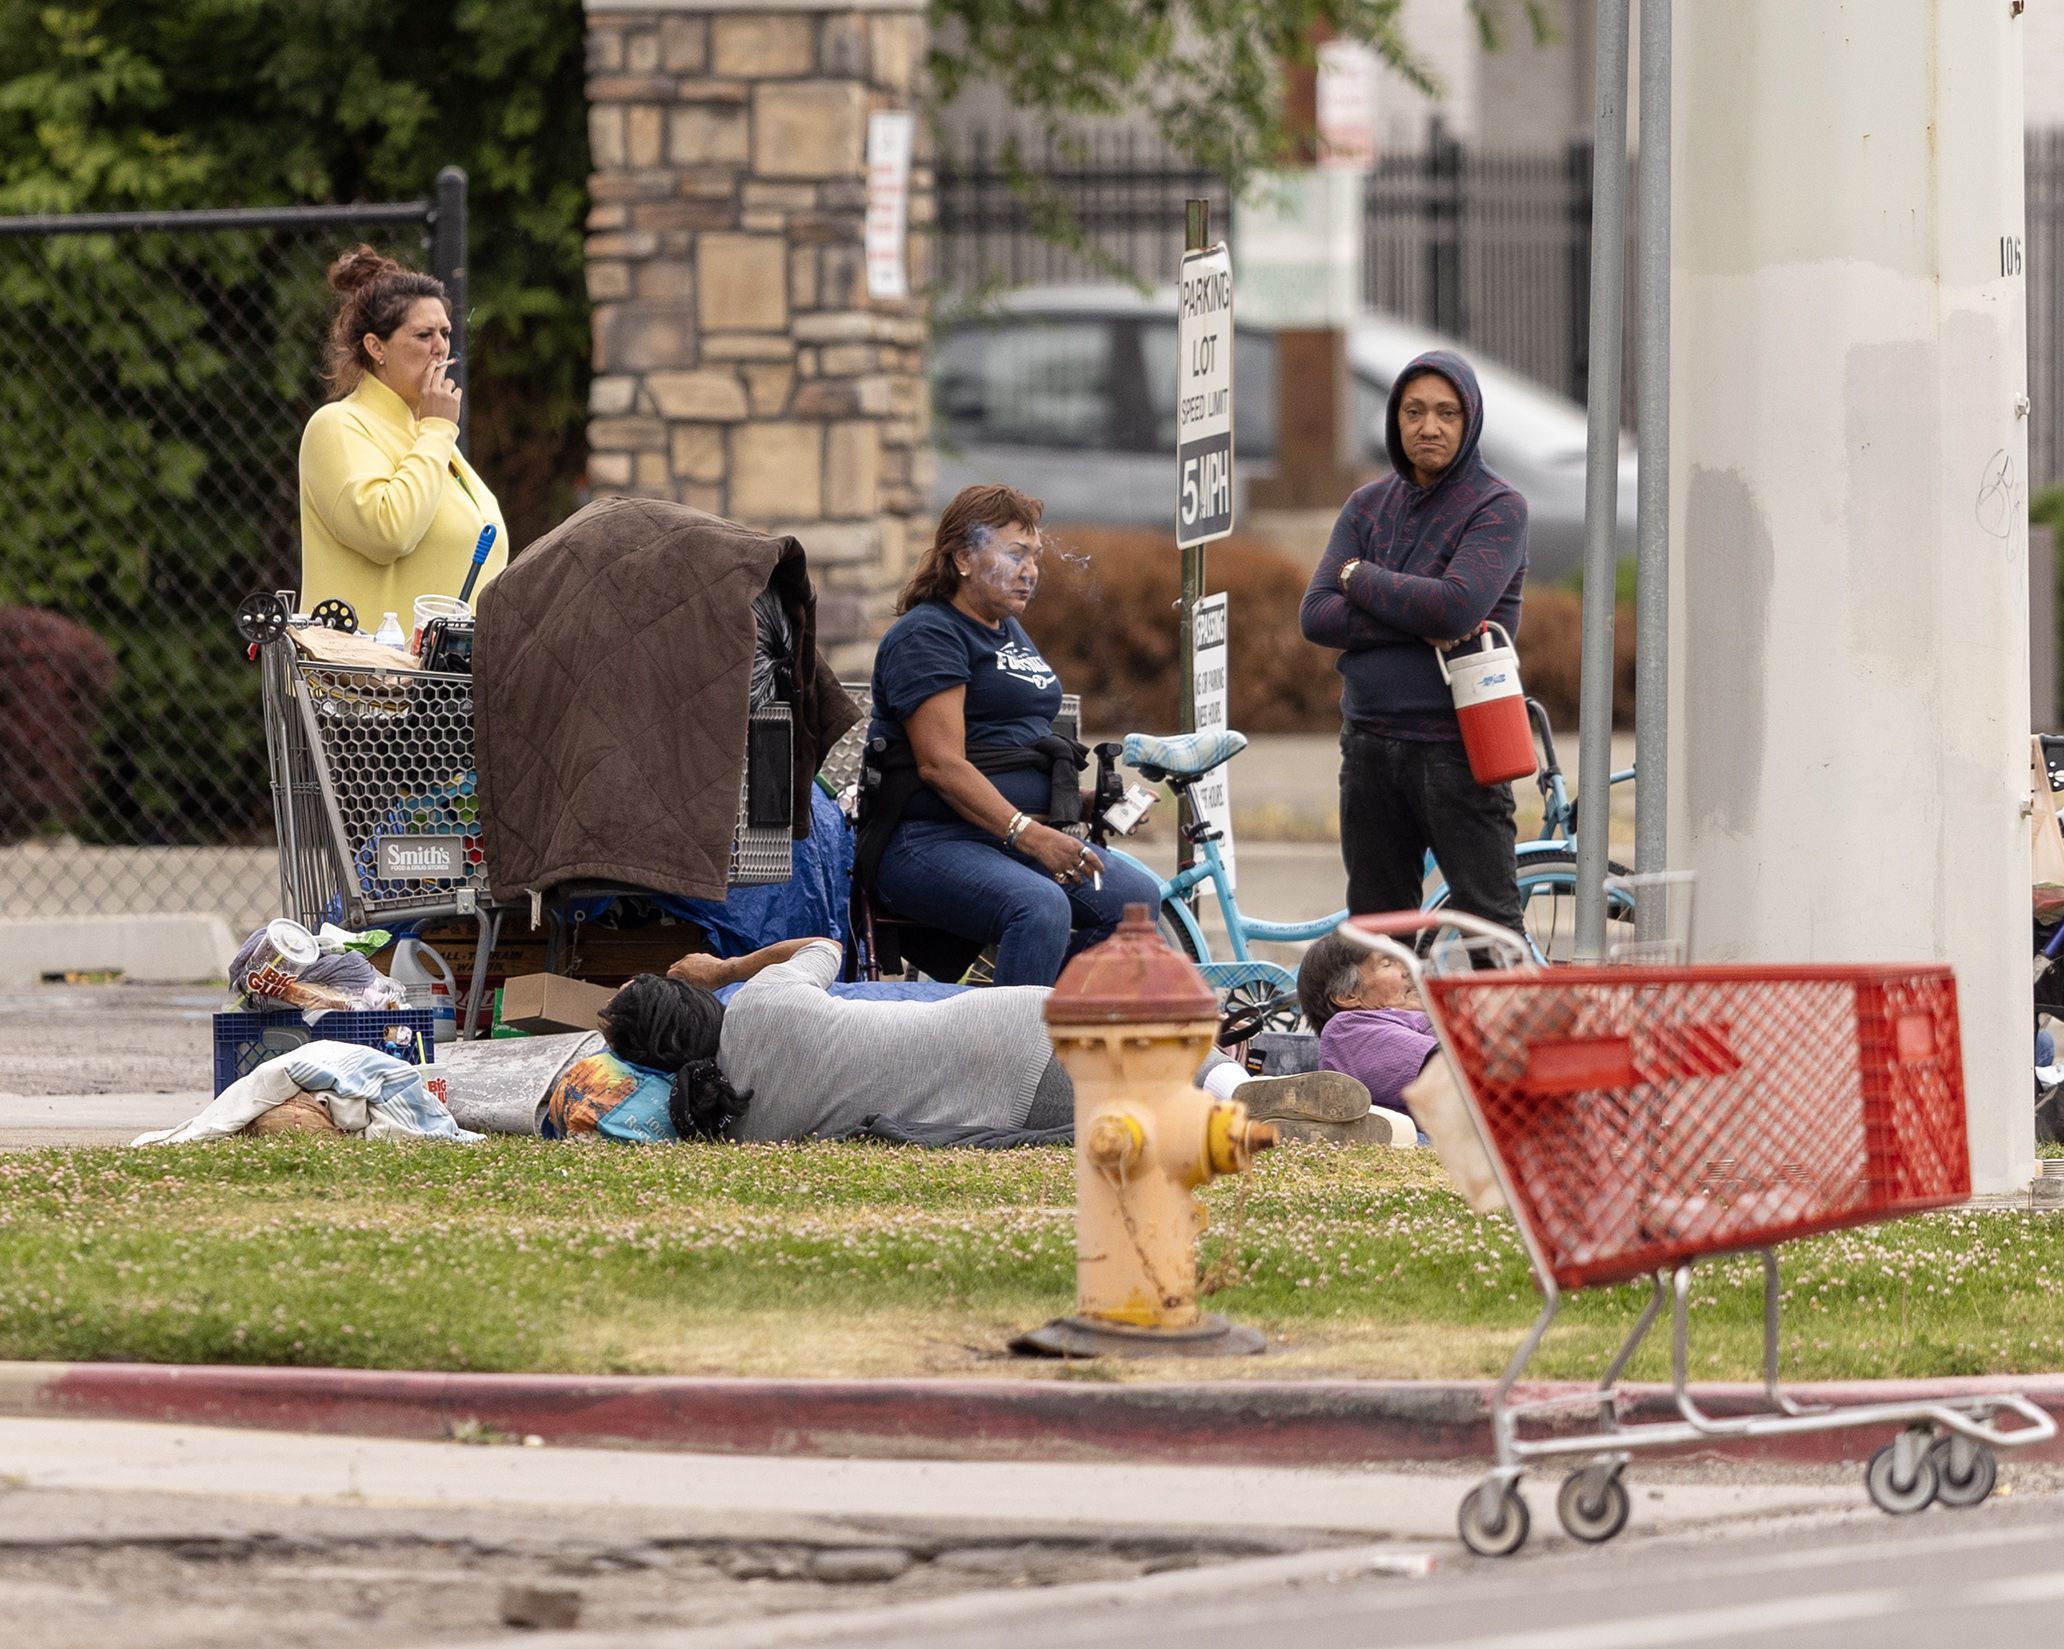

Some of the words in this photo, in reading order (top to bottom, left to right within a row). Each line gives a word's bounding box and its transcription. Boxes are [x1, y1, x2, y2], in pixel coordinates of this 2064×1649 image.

[2000, 236, 2021, 277] 106
[1183, 271, 1230, 319] PARKING
[1192, 334, 1217, 377] LOT
[1181, 395, 1205, 425] SPEED
[1208, 388, 1228, 417] LIMIT
[1182, 458, 1198, 525] 5
[1198, 449, 1230, 520] MPH
[388, 844, 451, 865] Smith's
